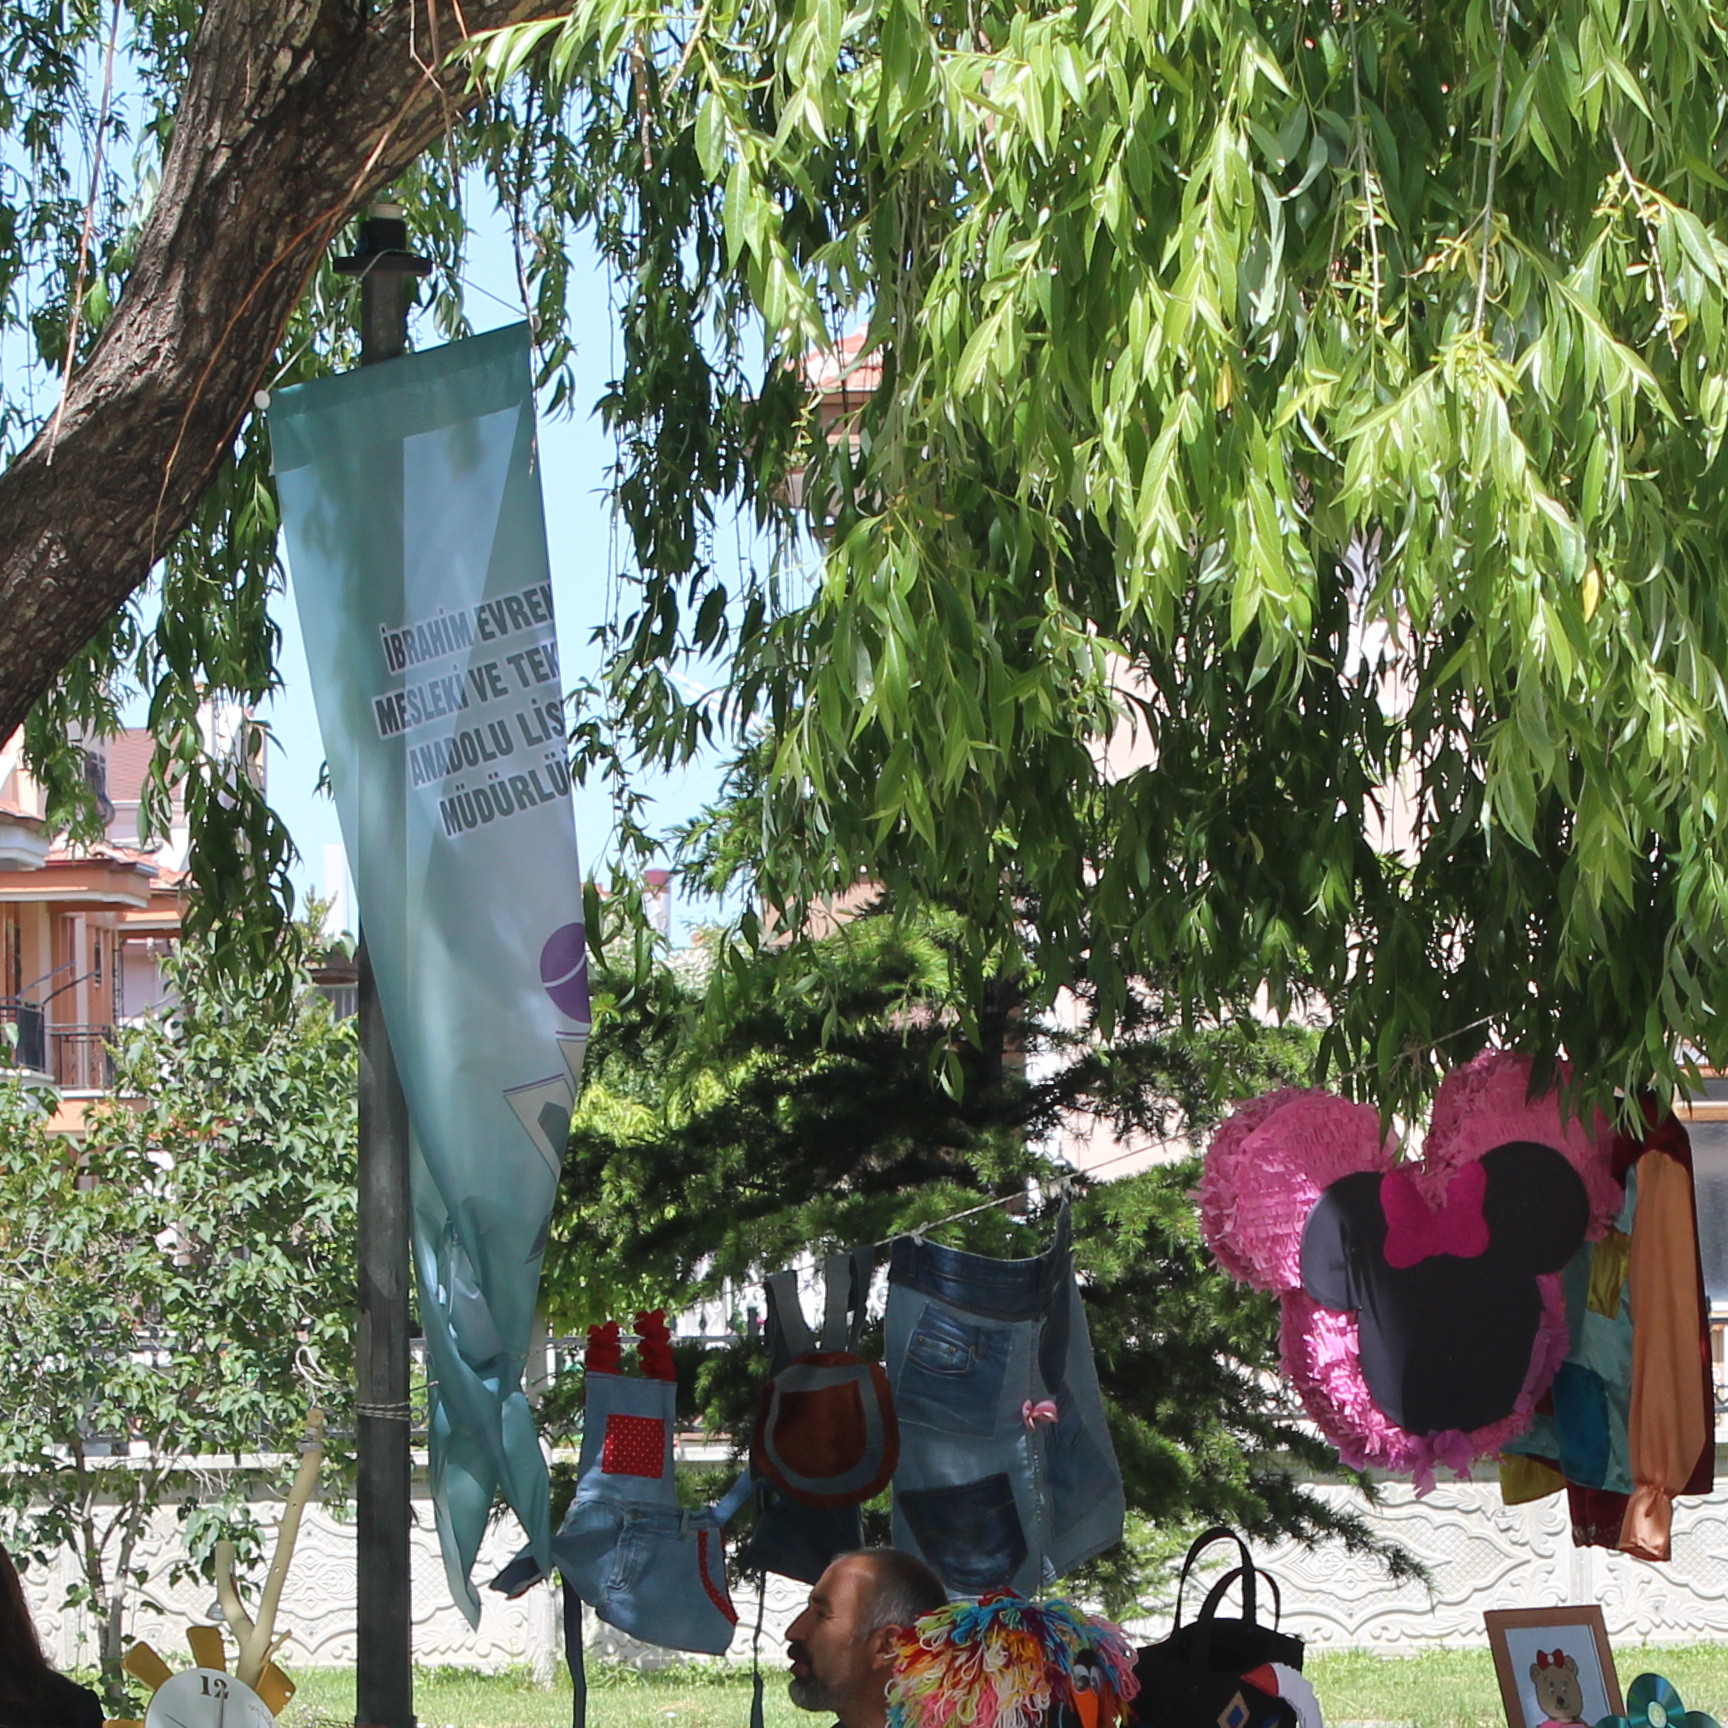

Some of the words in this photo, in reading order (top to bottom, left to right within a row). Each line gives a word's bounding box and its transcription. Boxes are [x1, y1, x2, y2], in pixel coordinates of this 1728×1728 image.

[381, 608, 472, 671] İBRAHİM
[375, 665, 469, 735] MESLEKİ
[468, 661, 509, 702] VE
[409, 720, 514, 787] ANADOLU
[516, 698, 565, 747] LİS
[200, 1675, 229, 1699] 12
